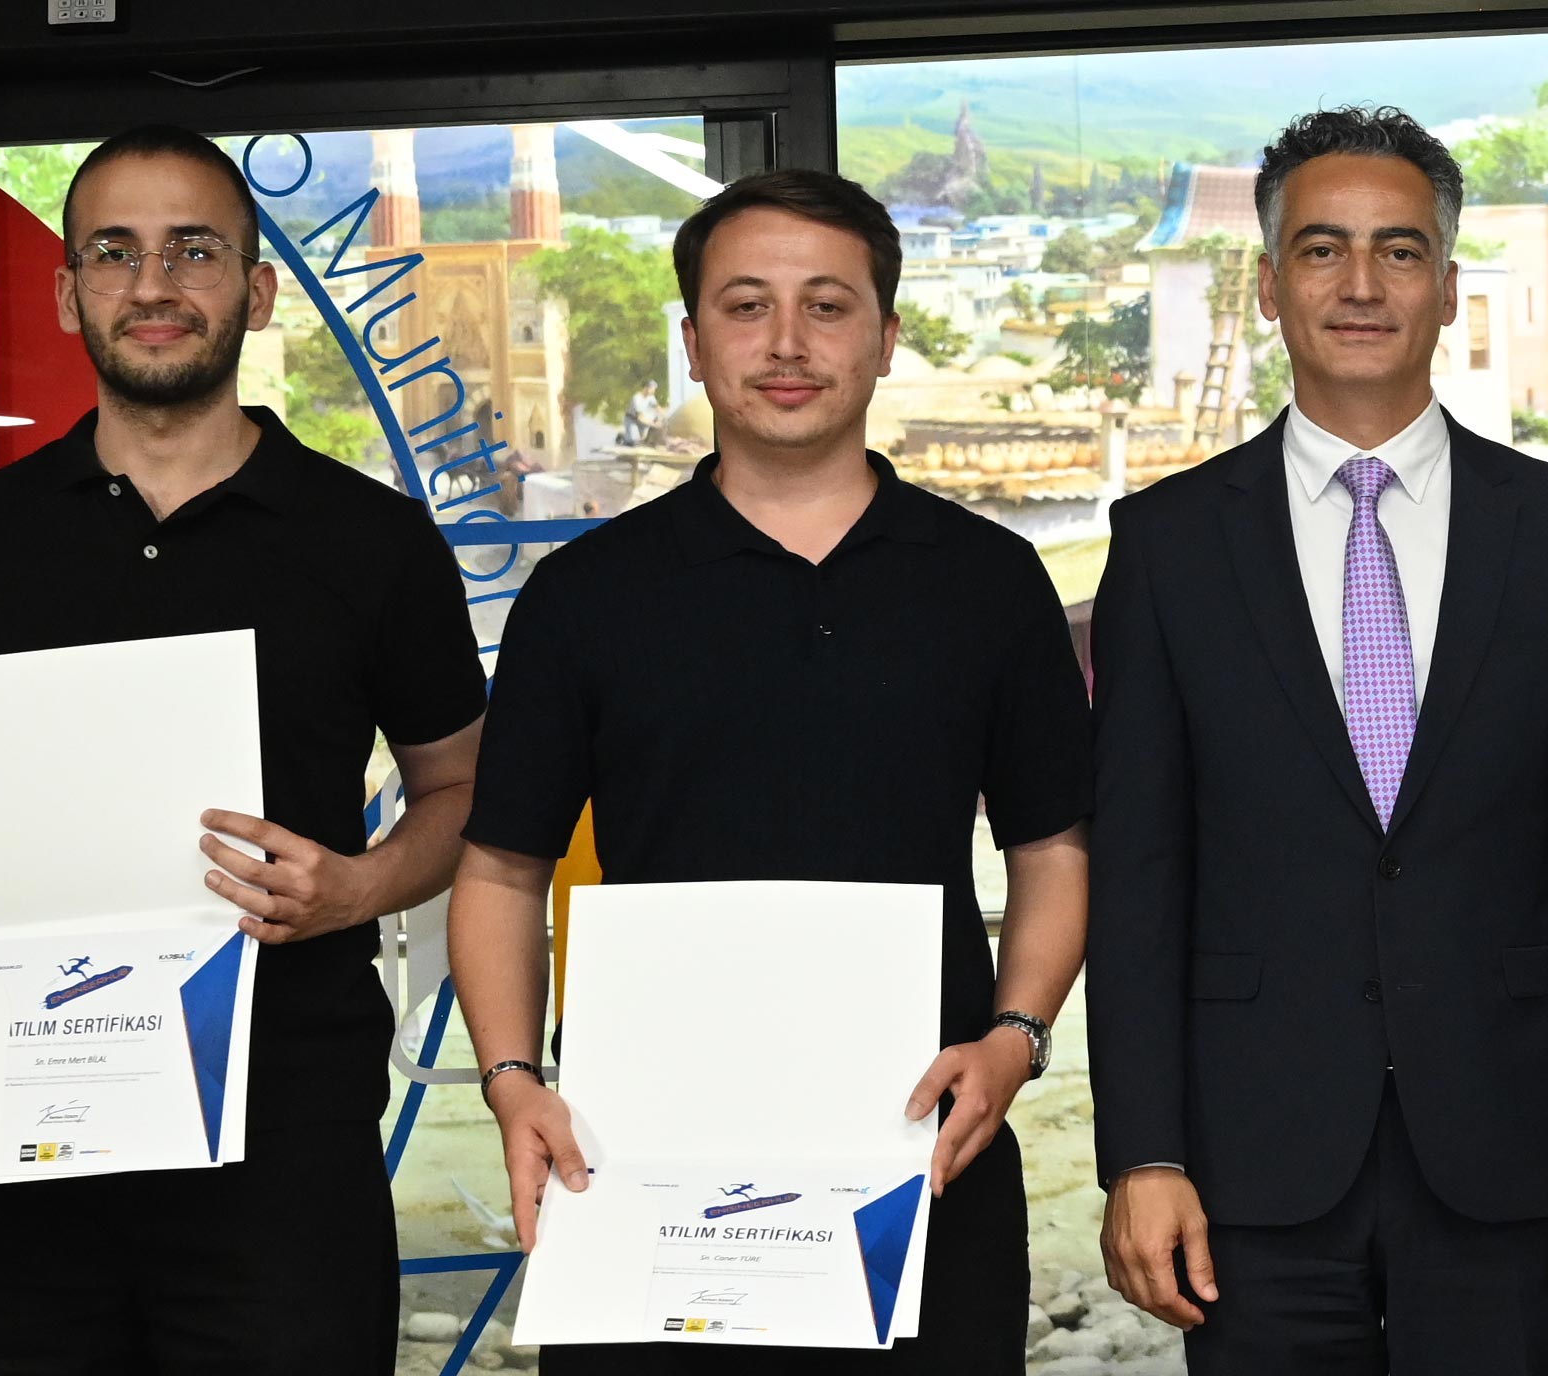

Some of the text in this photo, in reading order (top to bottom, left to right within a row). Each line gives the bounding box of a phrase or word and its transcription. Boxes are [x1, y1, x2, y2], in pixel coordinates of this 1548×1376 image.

[63, 1014, 163, 1035] SERTİFİKASI
[659, 1225, 833, 1242] ATILIM SERTİFİKASI
